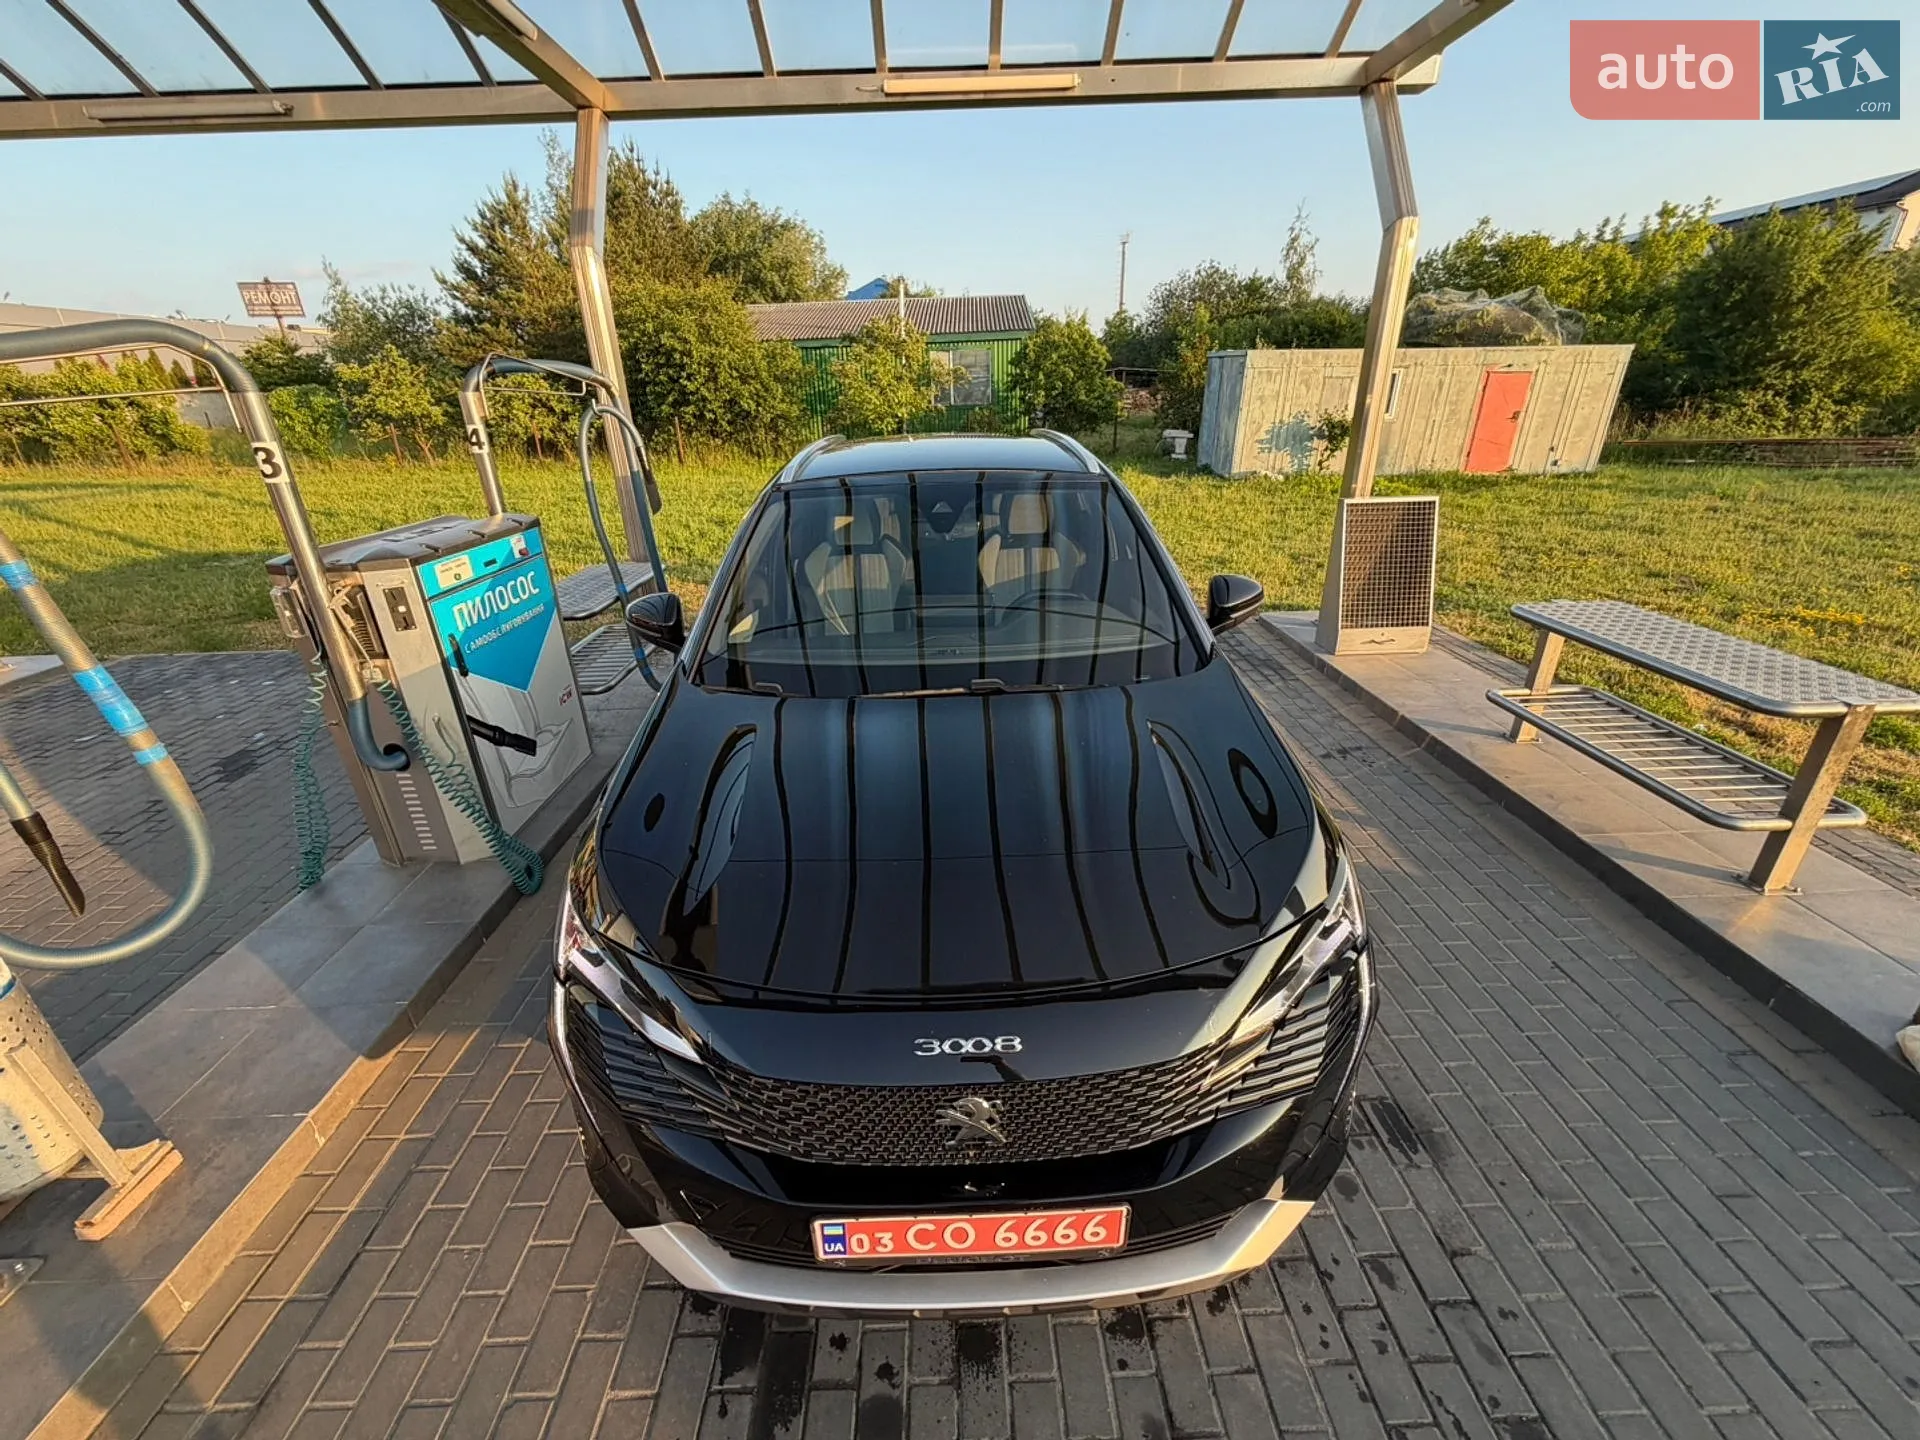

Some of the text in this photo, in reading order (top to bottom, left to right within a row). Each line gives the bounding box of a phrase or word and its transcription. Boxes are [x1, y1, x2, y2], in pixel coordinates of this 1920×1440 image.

[242, 290, 297, 305] РЕМОНТ
[468, 428, 485, 450] 4
[253, 447, 282, 479] 3
[452, 571, 540, 633] ПИЛОСОС
[913, 1035, 1023, 1056] 3008
[850, 1214, 1107, 1254] 03 CO 6666
[824, 1242, 844, 1253] UA
